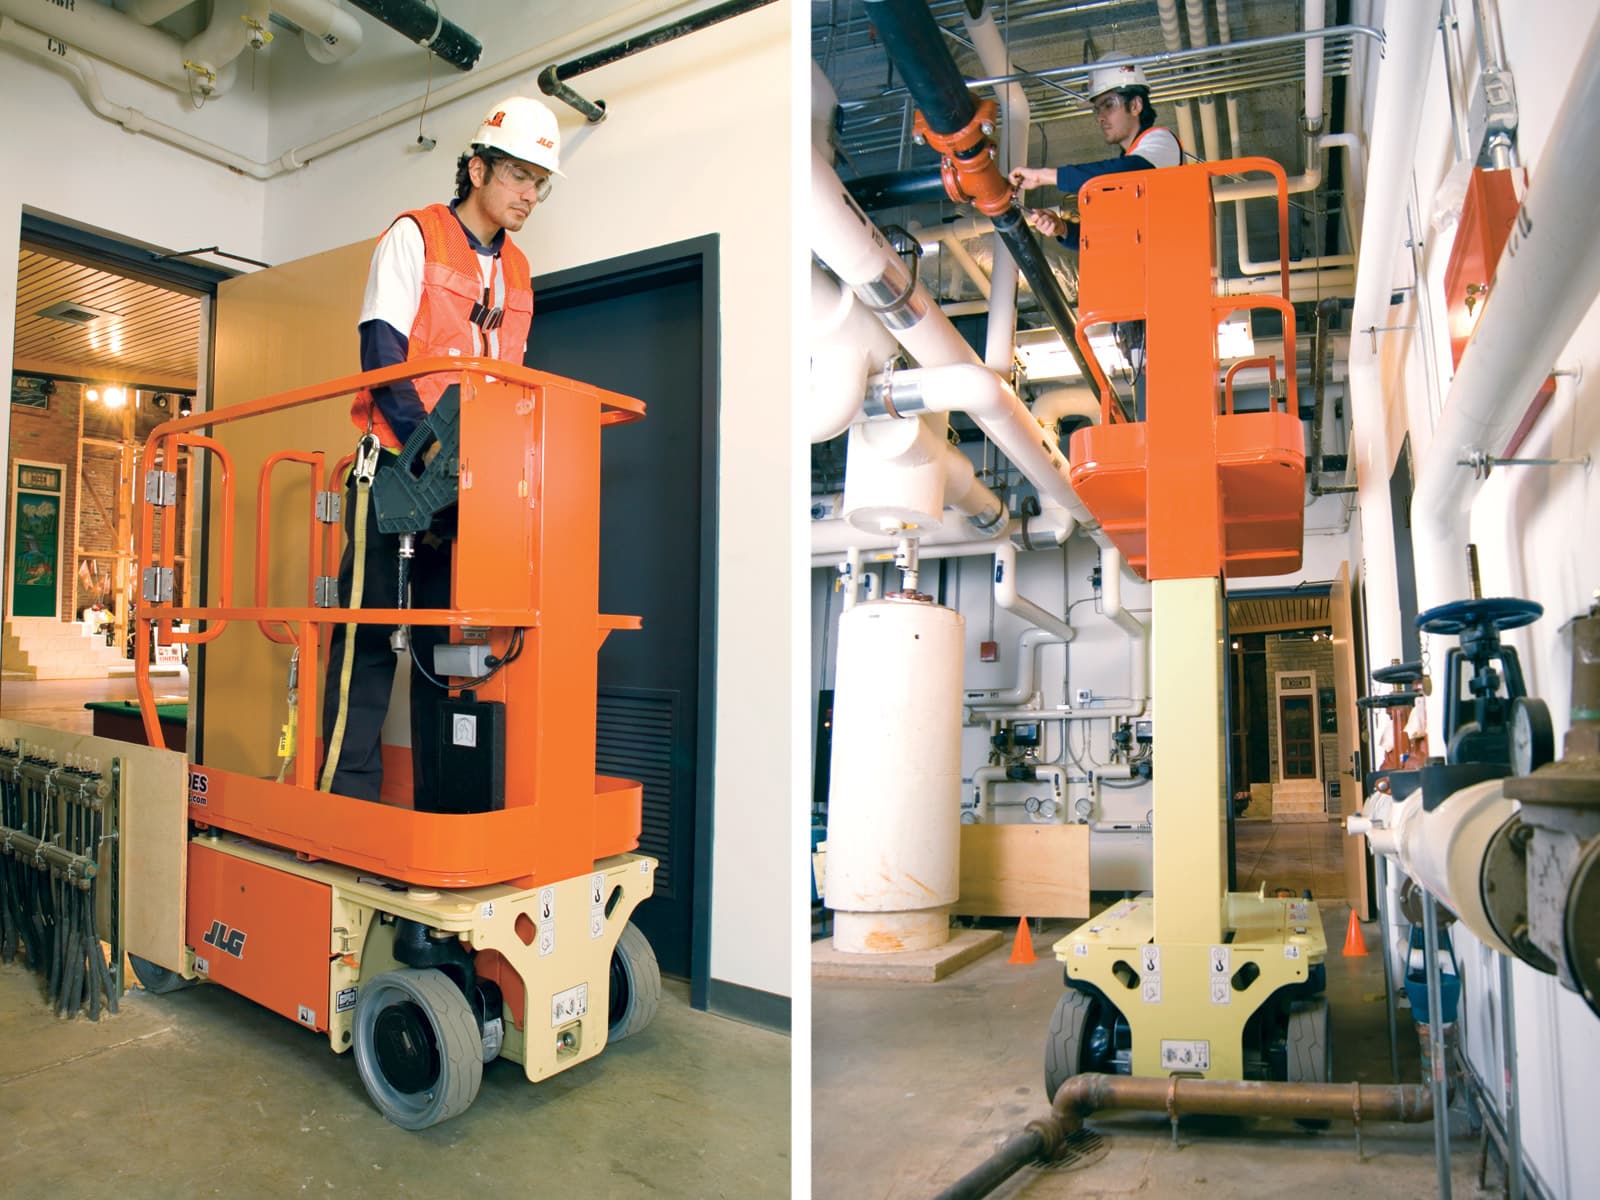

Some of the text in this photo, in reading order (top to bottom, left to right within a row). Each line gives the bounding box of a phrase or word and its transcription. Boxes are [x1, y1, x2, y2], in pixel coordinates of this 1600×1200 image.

[536, 137, 554, 149] JLG
[188, 773, 208, 793] ES
[189, 794, 207, 805] .com
[203, 920, 247, 958] JLG
